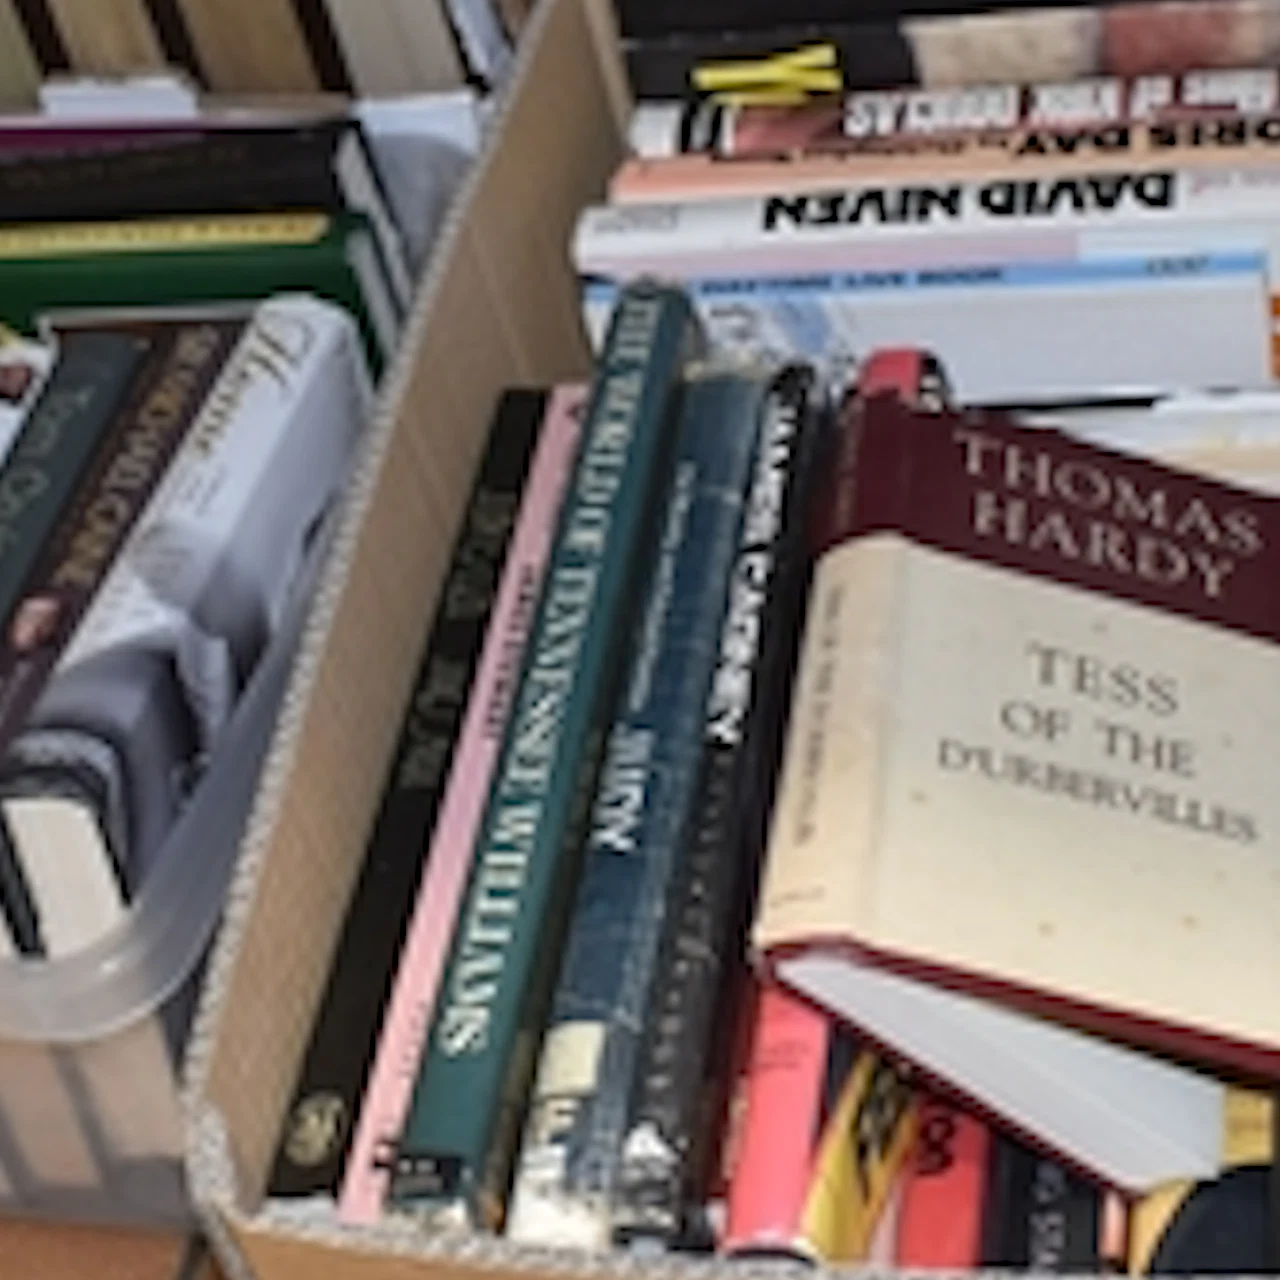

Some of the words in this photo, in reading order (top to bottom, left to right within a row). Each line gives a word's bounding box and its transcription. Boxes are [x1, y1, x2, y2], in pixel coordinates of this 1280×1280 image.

[1015, 125, 1130, 156] DAY
[761, 183, 962, 232] NIVEN
[979, 172, 1174, 217] DAVID
[607, 295, 661, 369] THE
[574, 365, 646, 506] WORLD
[562, 502, 612, 559] OF
[954, 428, 1265, 553] THOMAS
[971, 491, 1238, 600] HARDY
[501, 561, 599, 801] TENNESSEE
[701, 549, 774, 750] CAGNEY
[1028, 640, 1181, 718] TESS
[999, 698, 1072, 741] OF
[1094, 720, 1200, 780] THE
[935, 736, 1261, 846] D'URBERVILLES
[434, 793, 544, 1064] WILLIAMS
